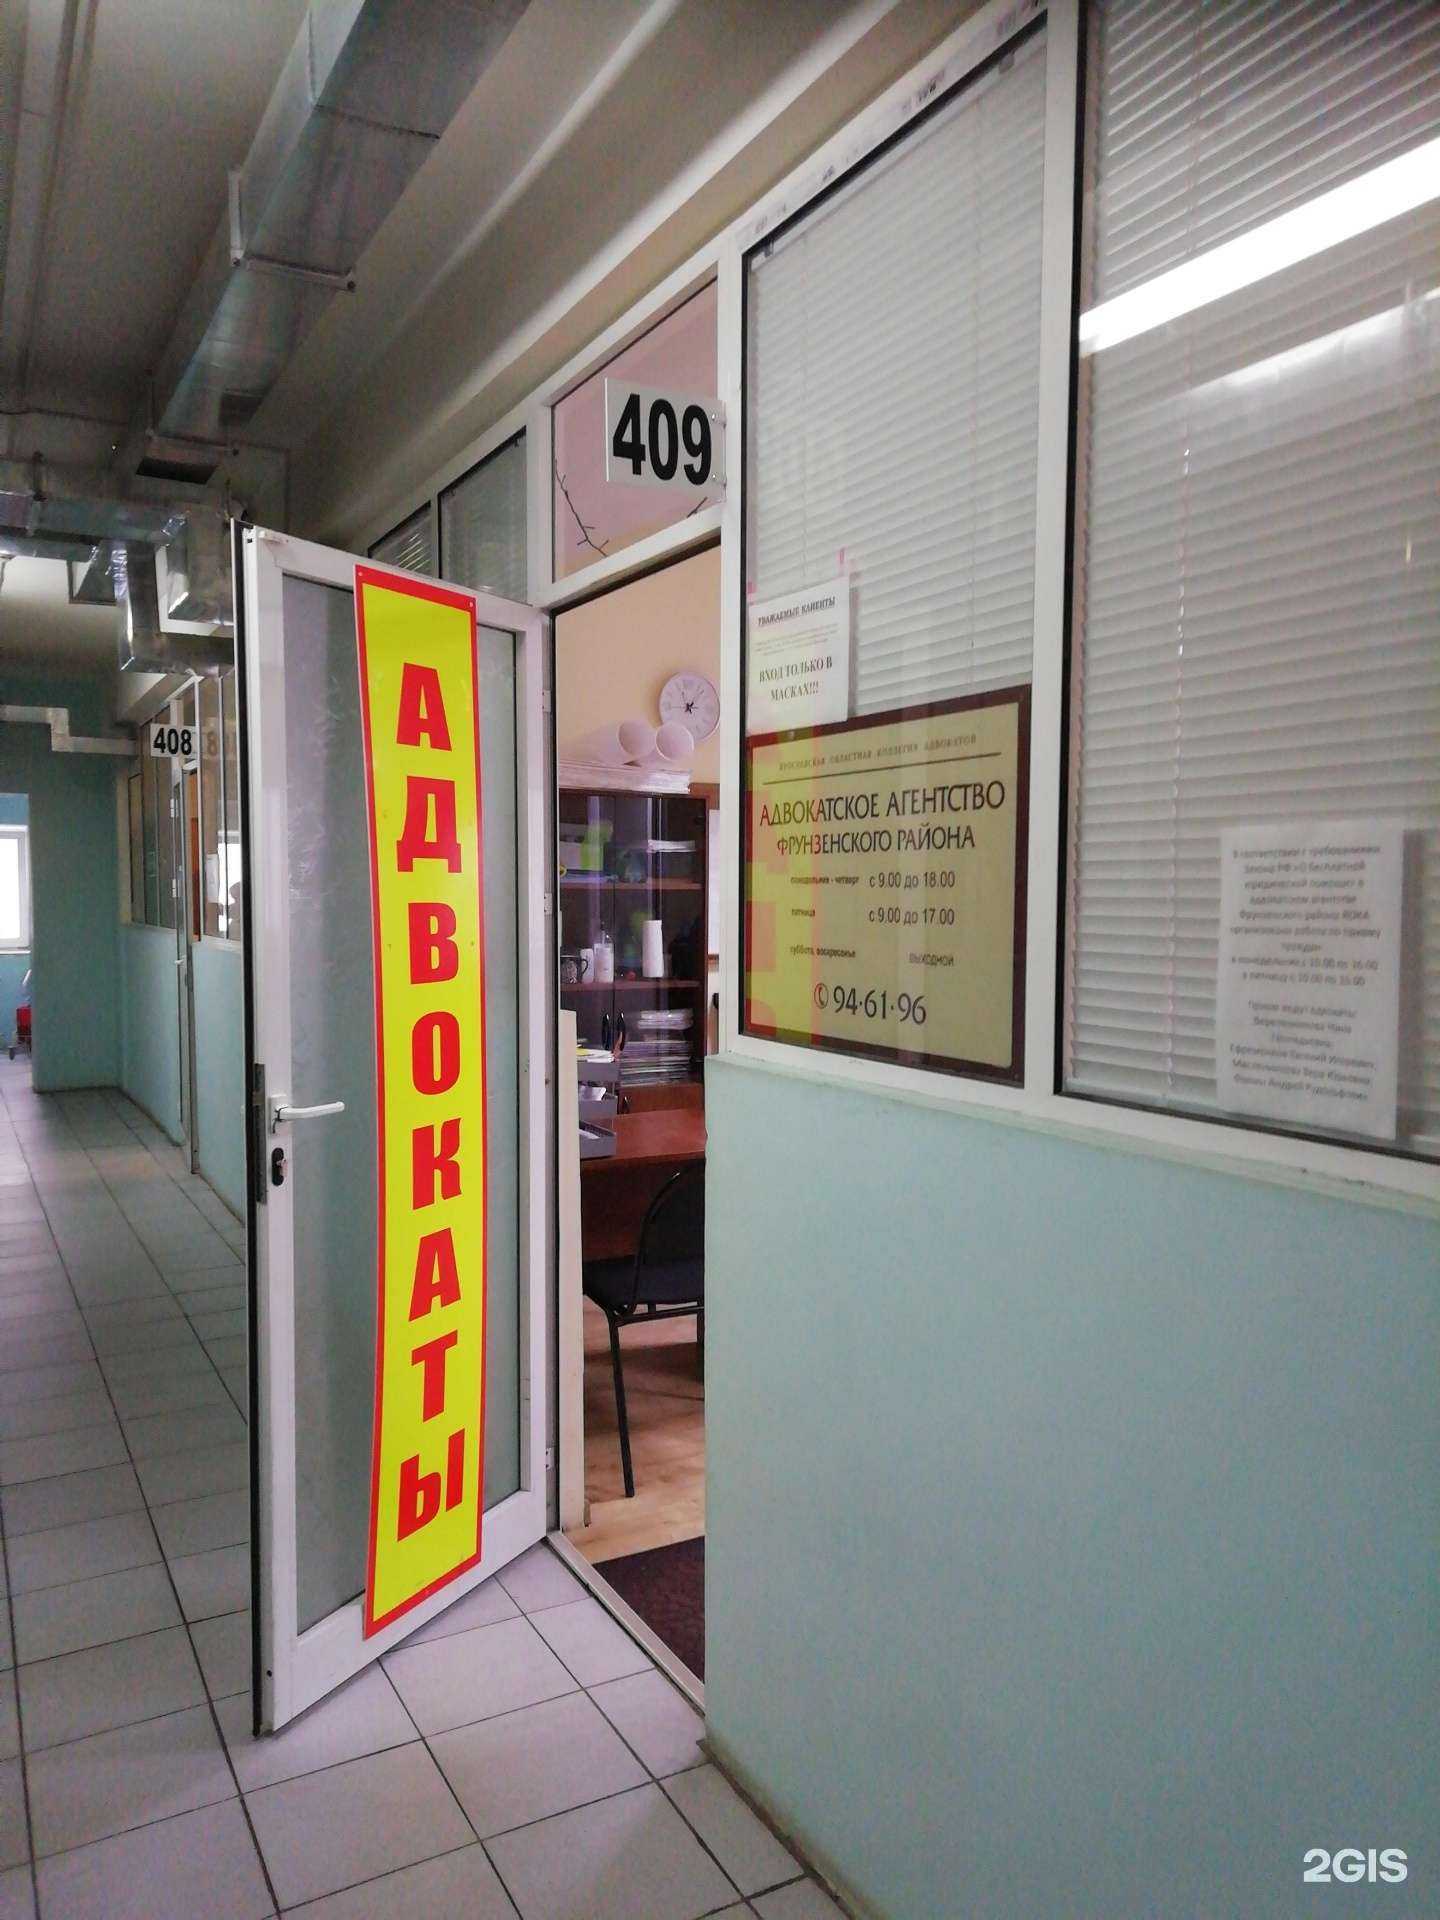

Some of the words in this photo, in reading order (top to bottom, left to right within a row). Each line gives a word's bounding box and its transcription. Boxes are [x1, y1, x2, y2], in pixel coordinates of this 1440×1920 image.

[613, 393, 711, 485] 409
[759, 667, 783, 683] ВХОД
[786, 658, 824, 678] ТОЛЬКО
[826, 656, 833, 669] В
[771, 680, 819, 701] МАСКАХ!!!
[153, 728, 192, 755] 408
[760, 793, 880, 826] АДВОКАТСКОЕ
[886, 781, 1006, 817] АГЕНТСТВО
[777, 830, 892, 856] ФРУНЗЕНСКОГО
[897, 823, 976, 851] РАЙОНА
[869, 876, 875, 888] с
[878, 871, 901, 888] 9.00
[904, 876, 919, 890] до
[924, 870, 956, 888] 18.00
[869, 910, 875, 922] с
[878, 906, 901, 924] 9.00
[903, 912, 919, 926] до
[923, 907, 955, 925] 17.00
[397, 662, 464, 1543] АДВОКАТЫ
